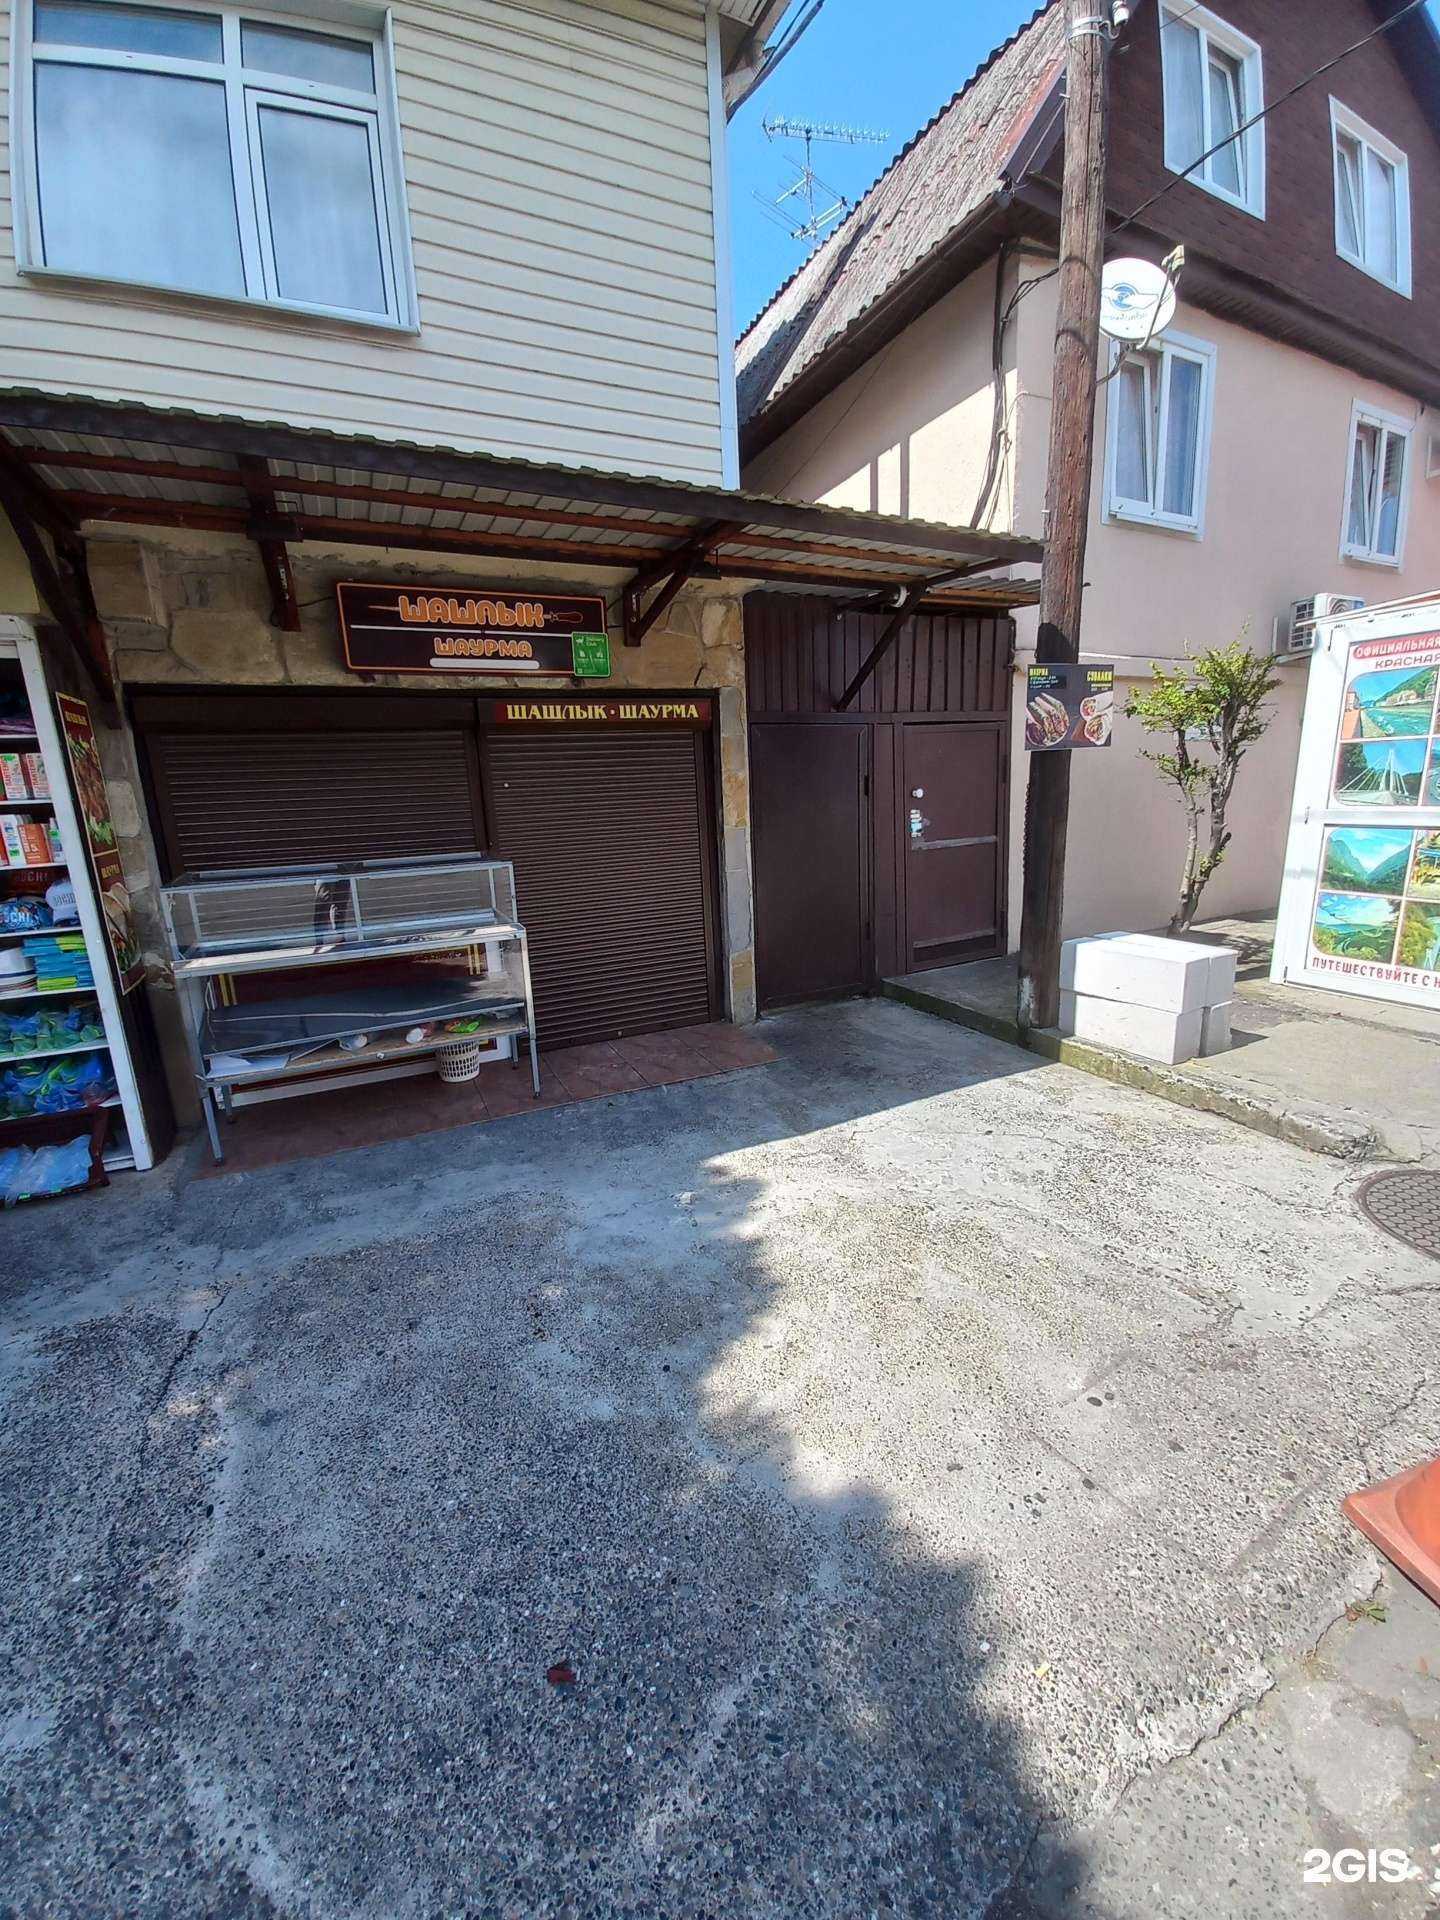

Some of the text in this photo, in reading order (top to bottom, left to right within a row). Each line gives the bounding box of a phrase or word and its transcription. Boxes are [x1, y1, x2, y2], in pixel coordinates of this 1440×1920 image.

[399, 595, 545, 628] ШАШЛЫК
[434, 637, 533, 658] ШАУРМА
[1356, 636, 1440, 658] ОФИЦИАЛЬНАЯ
[506, 704, 699, 720] ШАШЛЫК ШАУРМА
[1312, 957, 1418, 984] ПУТЕШЕСТВУЙТЕ
[1422, 975, 1430, 986] С
